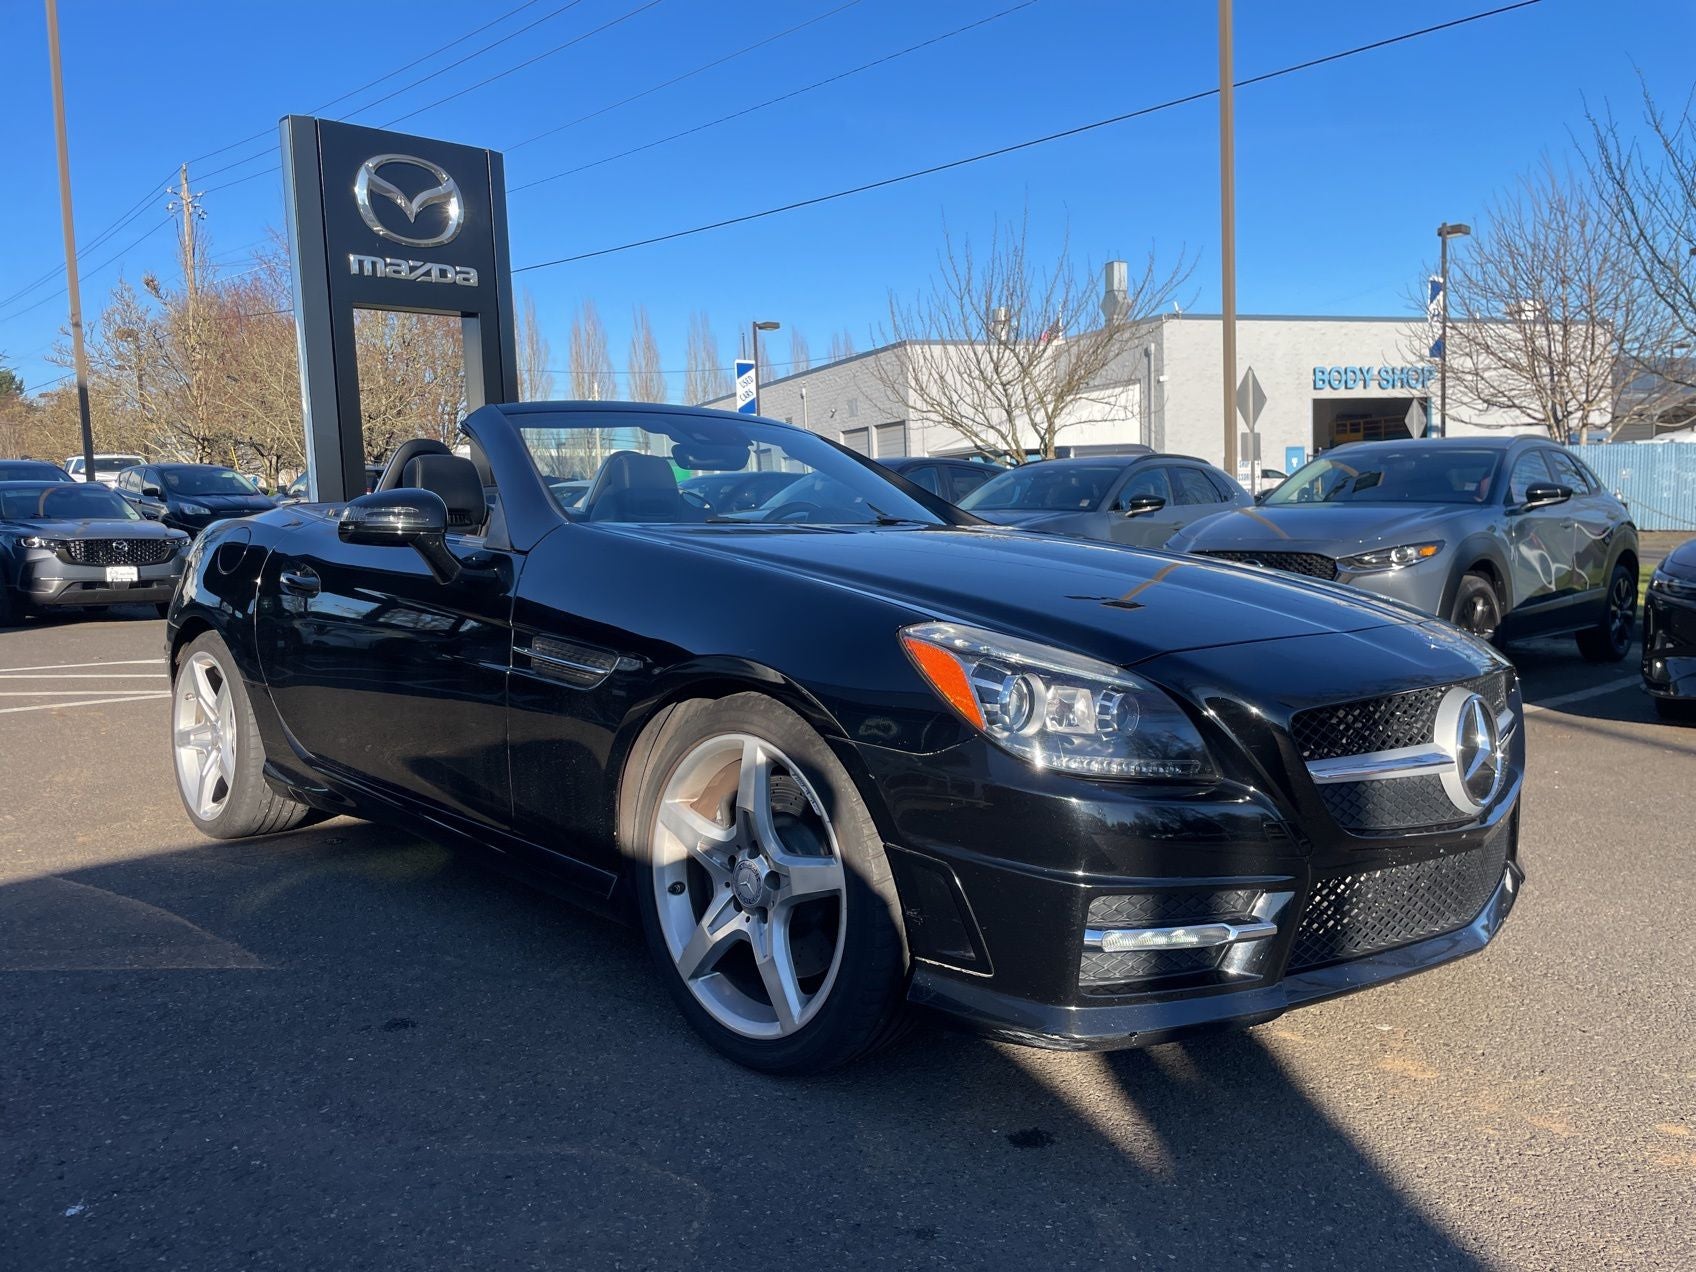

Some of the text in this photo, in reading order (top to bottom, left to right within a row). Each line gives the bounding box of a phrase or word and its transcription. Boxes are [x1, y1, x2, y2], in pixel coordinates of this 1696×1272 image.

[349, 253, 479, 287] mazda
[739, 375, 754, 389] USED
[1313, 366, 1437, 390] BODY SHOP
[739, 389, 754, 402] CARS
